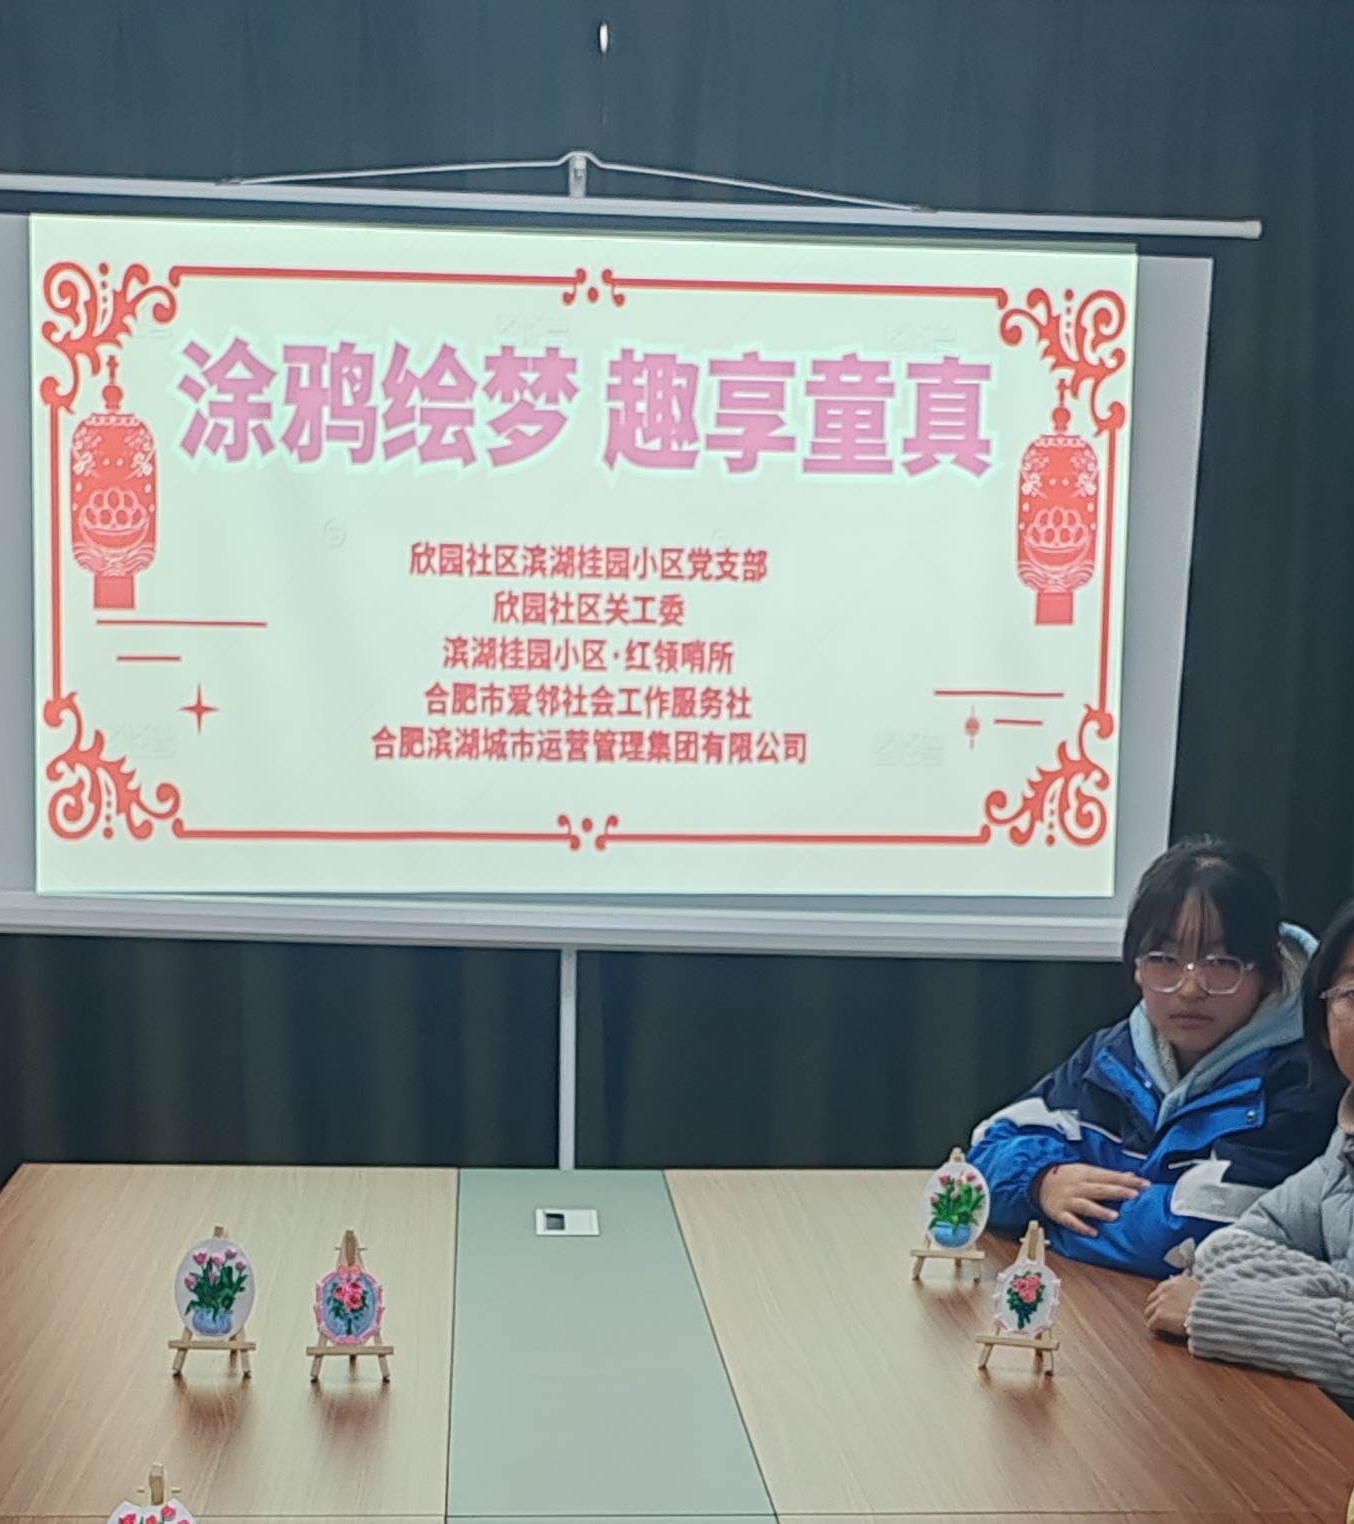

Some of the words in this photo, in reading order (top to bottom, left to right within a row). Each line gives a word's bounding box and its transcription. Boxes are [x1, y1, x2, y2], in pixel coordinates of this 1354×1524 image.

[180, 339, 581, 468] 涂鸦绘梦
[604, 347, 991, 476] 趣享童真
[410, 542, 768, 582] 欣园社区滨湖桂园小区党支部
[493, 592, 685, 626] 欣园社区关工委
[424, 682, 752, 720] 合肥市爱邻社会工作服务社
[372, 726, 808, 765] 合肥滨湖城市运营管理集团有限公司
